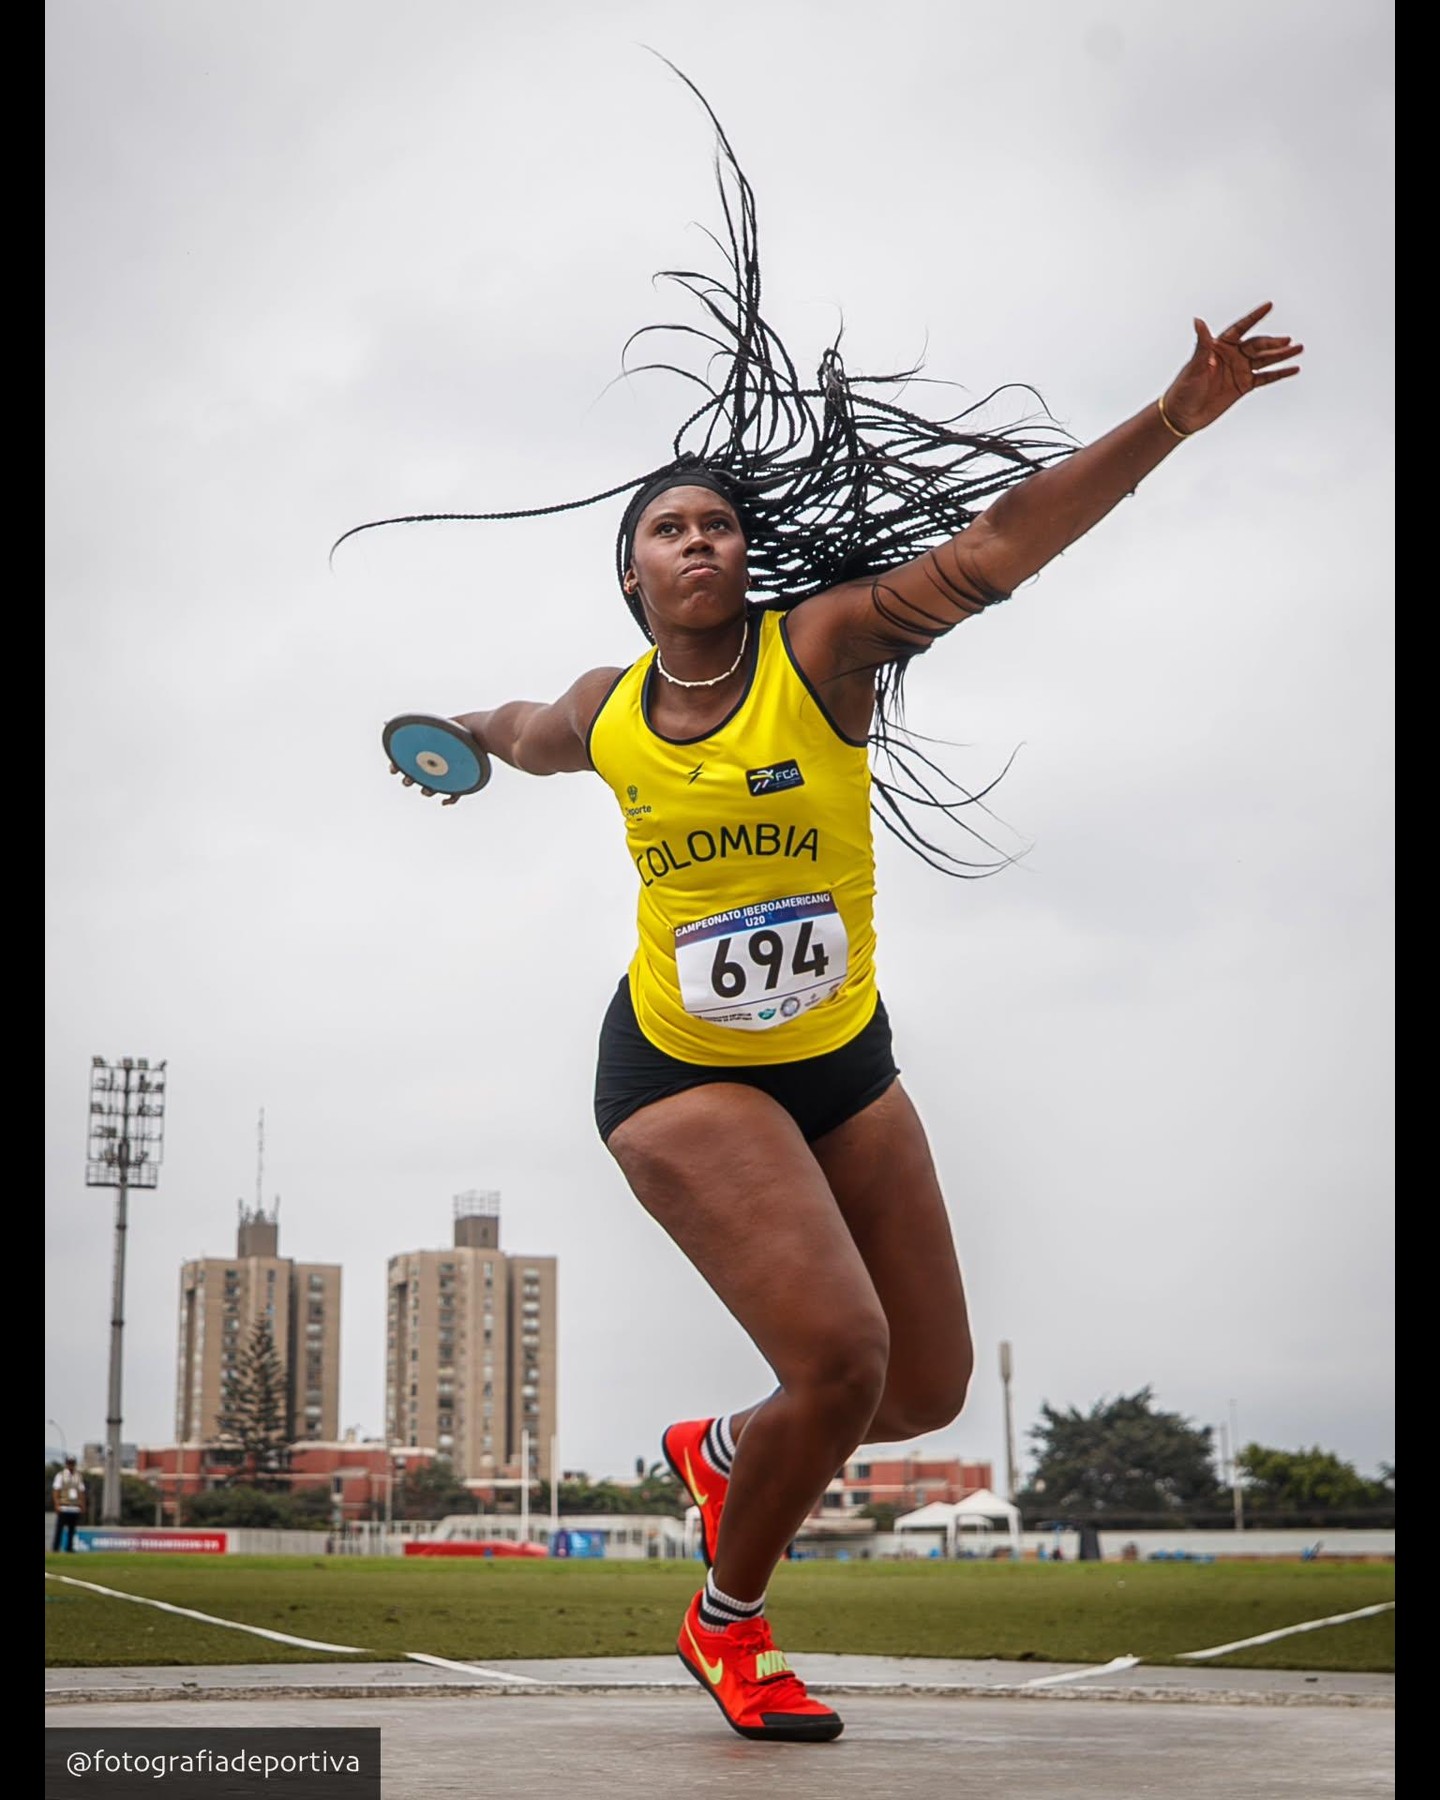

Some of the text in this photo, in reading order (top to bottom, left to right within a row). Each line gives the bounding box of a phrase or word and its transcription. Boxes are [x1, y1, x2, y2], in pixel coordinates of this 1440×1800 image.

[775, 767, 799, 781] FCA
[636, 823, 819, 887] COLOMBIA
[675, 893, 830, 937] CAMPEONATO IBEROAMERICANO
[745, 915, 766, 928] U20
[711, 921, 829, 999] 694
[756, 1650, 791, 1679] NIK
